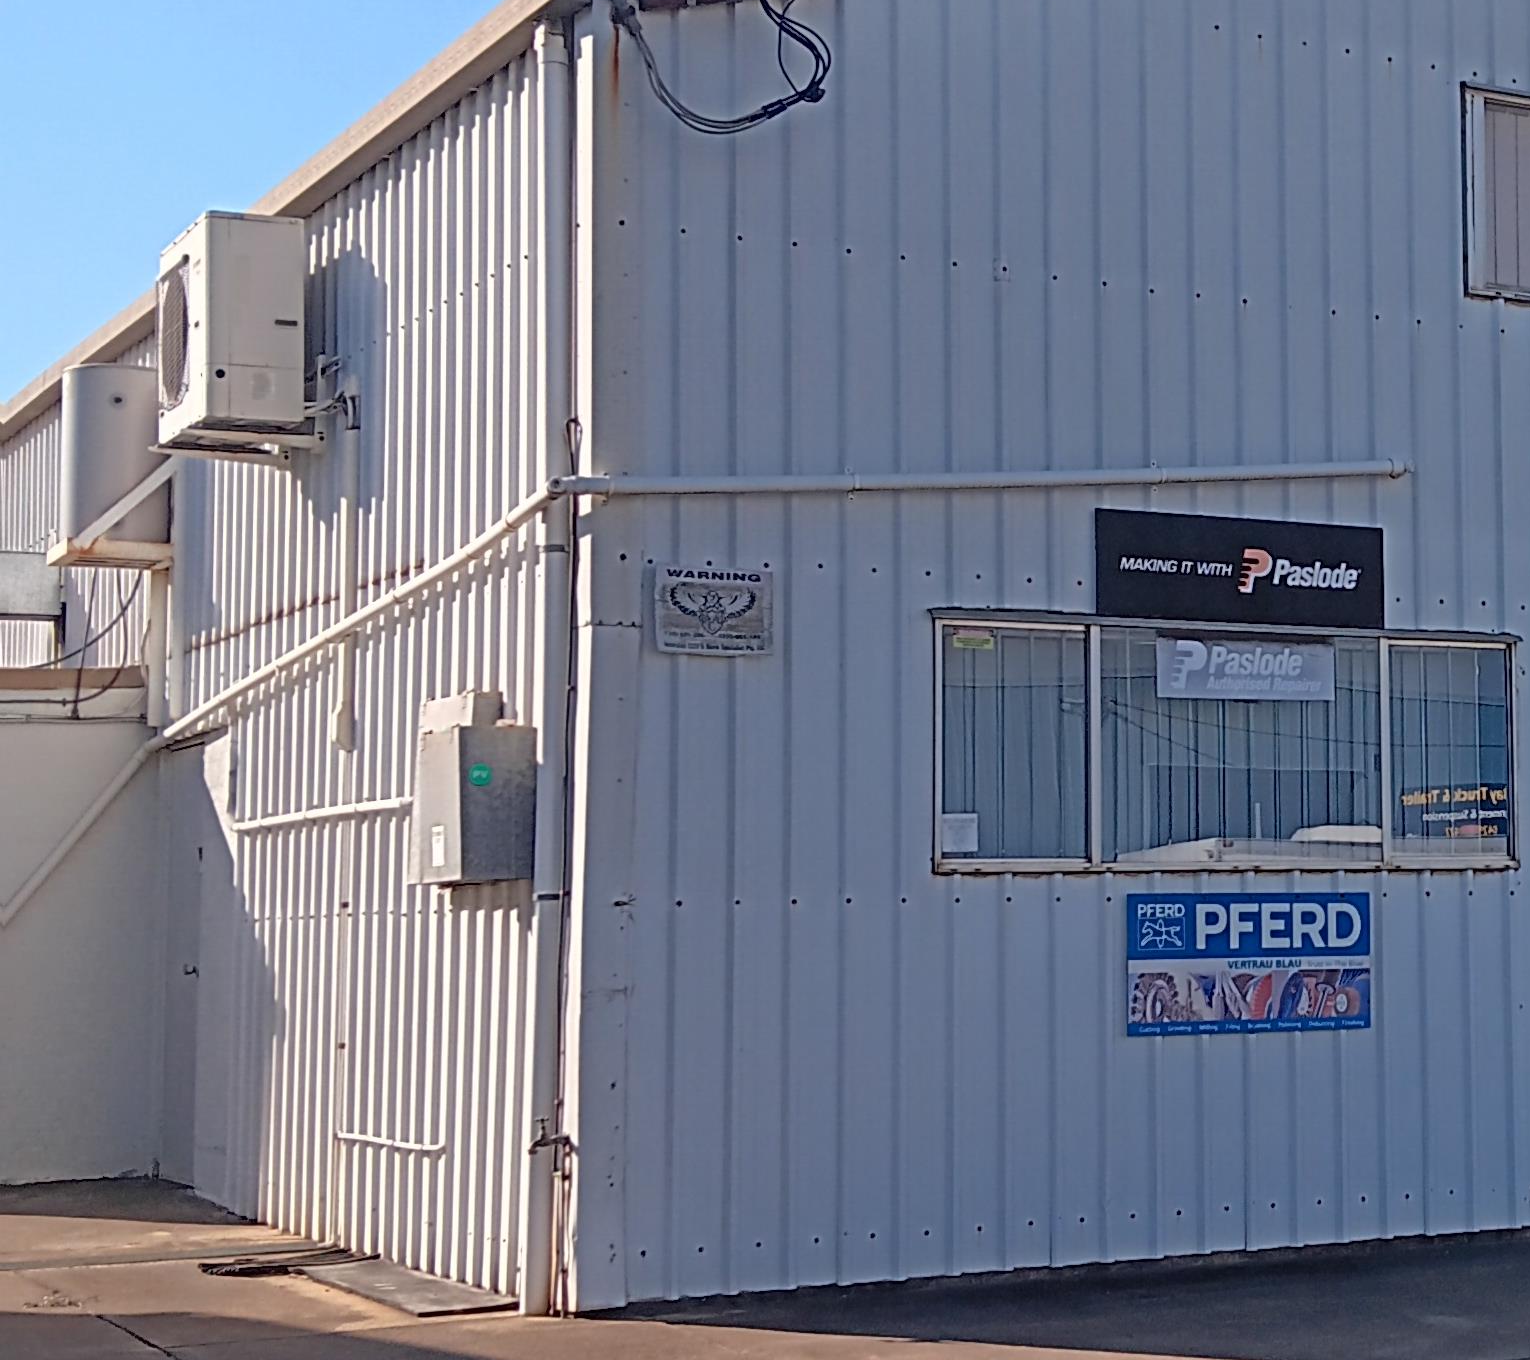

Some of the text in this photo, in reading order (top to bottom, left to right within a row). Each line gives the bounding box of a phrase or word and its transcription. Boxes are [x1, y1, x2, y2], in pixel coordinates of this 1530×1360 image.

[667, 569, 762, 583] WARNING
[1119, 557, 1178, 573] MAKING
[1180, 560, 1194, 574] IT
[1196, 561, 1233, 577] WITH
[1272, 559, 1359, 590] Paslode
[1208, 645, 1303, 677] Paslode
[1137, 903, 1186, 919] PFERD
[1195, 902, 1362, 950] PFERD
[1227, 960, 1273, 969] VERTRAU
[1275, 959, 1302, 969] BLAU
